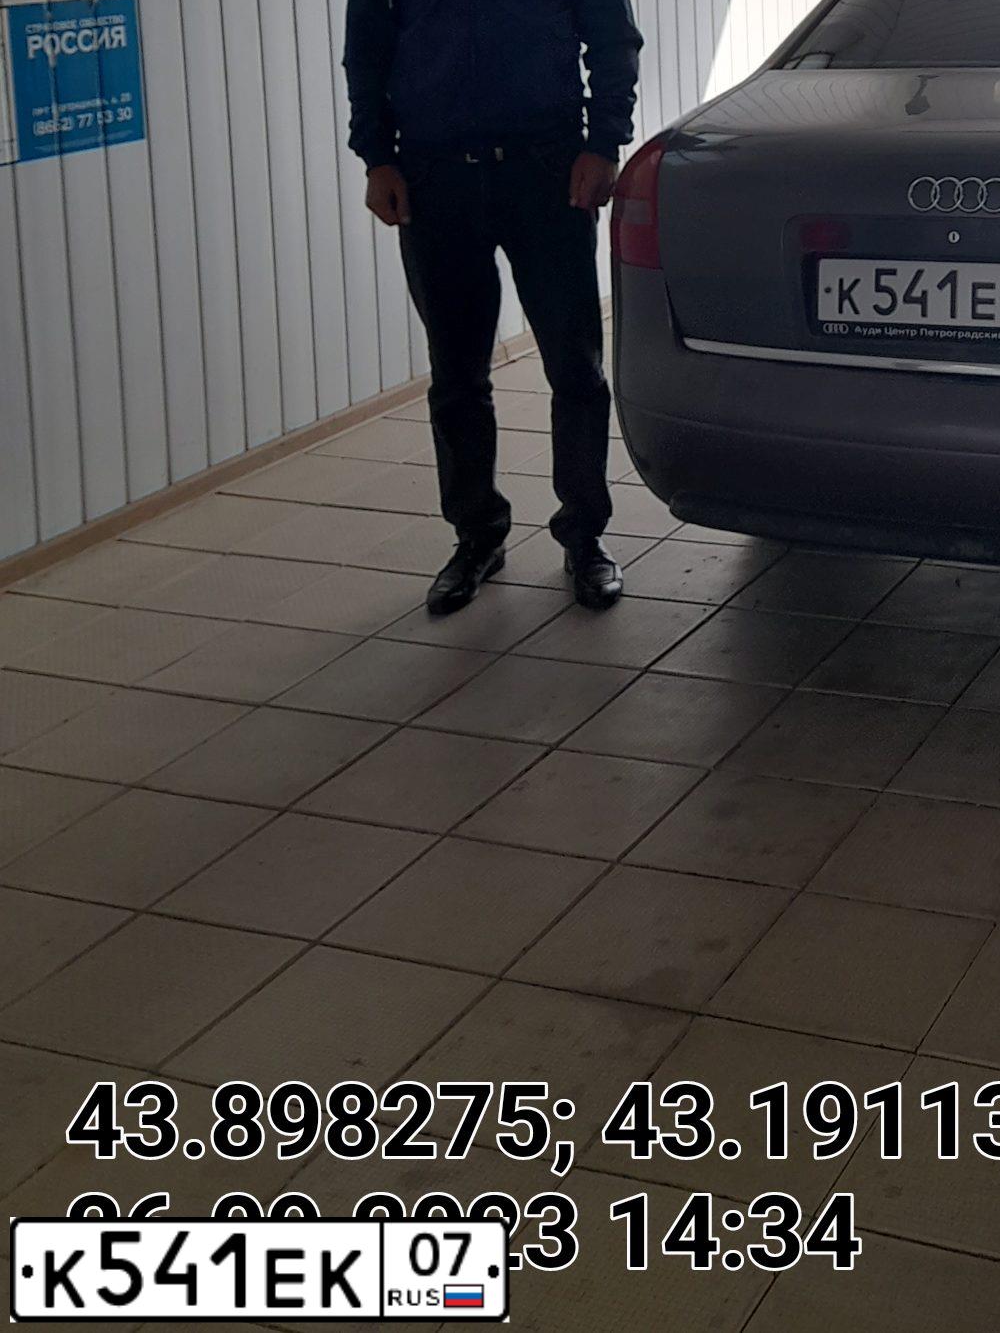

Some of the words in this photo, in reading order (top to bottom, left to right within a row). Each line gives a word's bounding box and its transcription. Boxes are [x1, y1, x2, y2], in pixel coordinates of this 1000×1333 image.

[27, 26, 126, 58] РОССИЯ
[854, 325, 883, 336] Ауди
[884, 327, 917, 338] Центр
